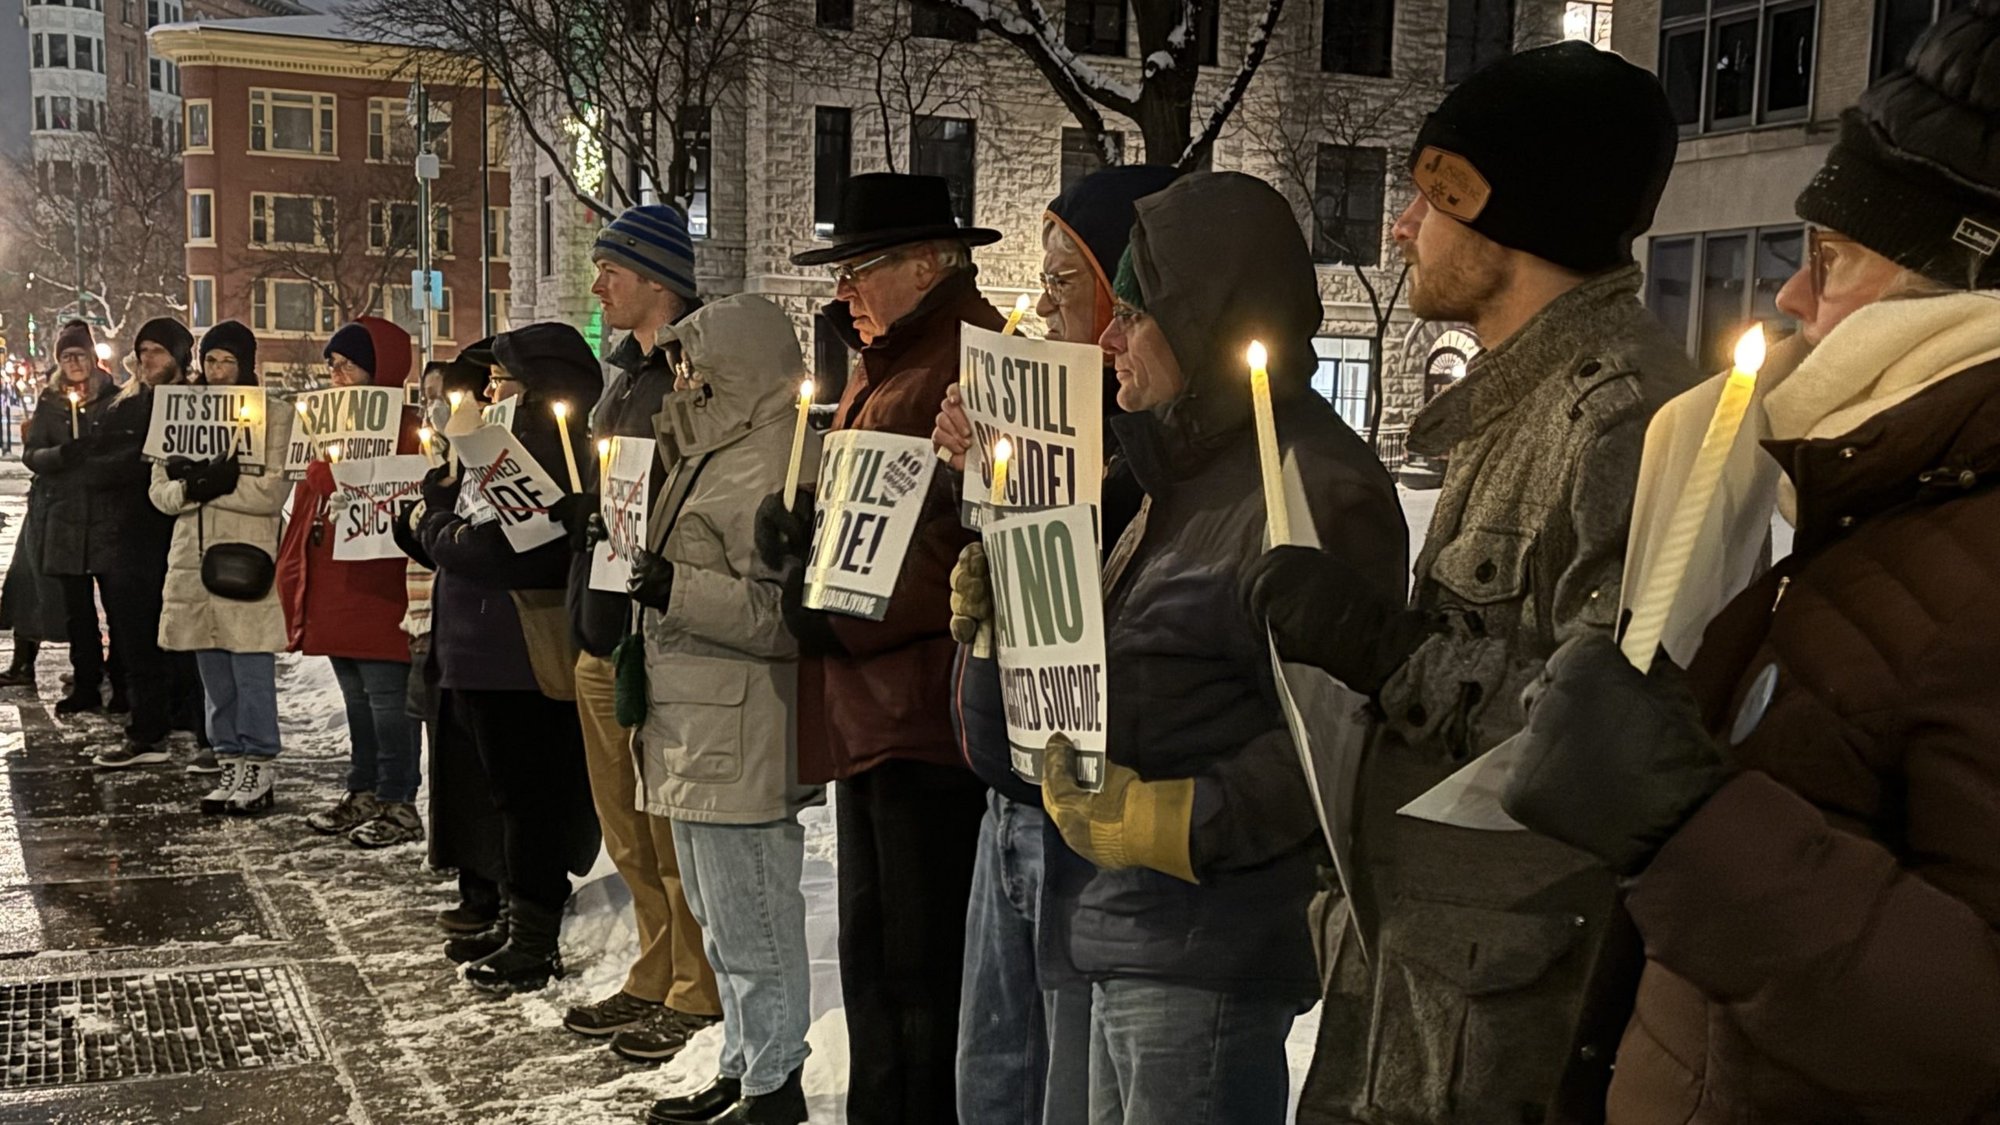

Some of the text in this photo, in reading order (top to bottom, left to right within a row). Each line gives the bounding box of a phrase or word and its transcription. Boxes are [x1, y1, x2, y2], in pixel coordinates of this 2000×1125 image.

[166, 393, 197, 421] IT'S
[302, 390, 390, 435] SAY NO
[966, 346, 1077, 437] IT'S STILL
[290, 442, 304, 464] TO
[345, 437, 394, 461] SUICIDE
[897, 450, 922, 476] NO
[1011, 520, 1084, 647] NO
[1039, 663, 1102, 732] SUICIDE
